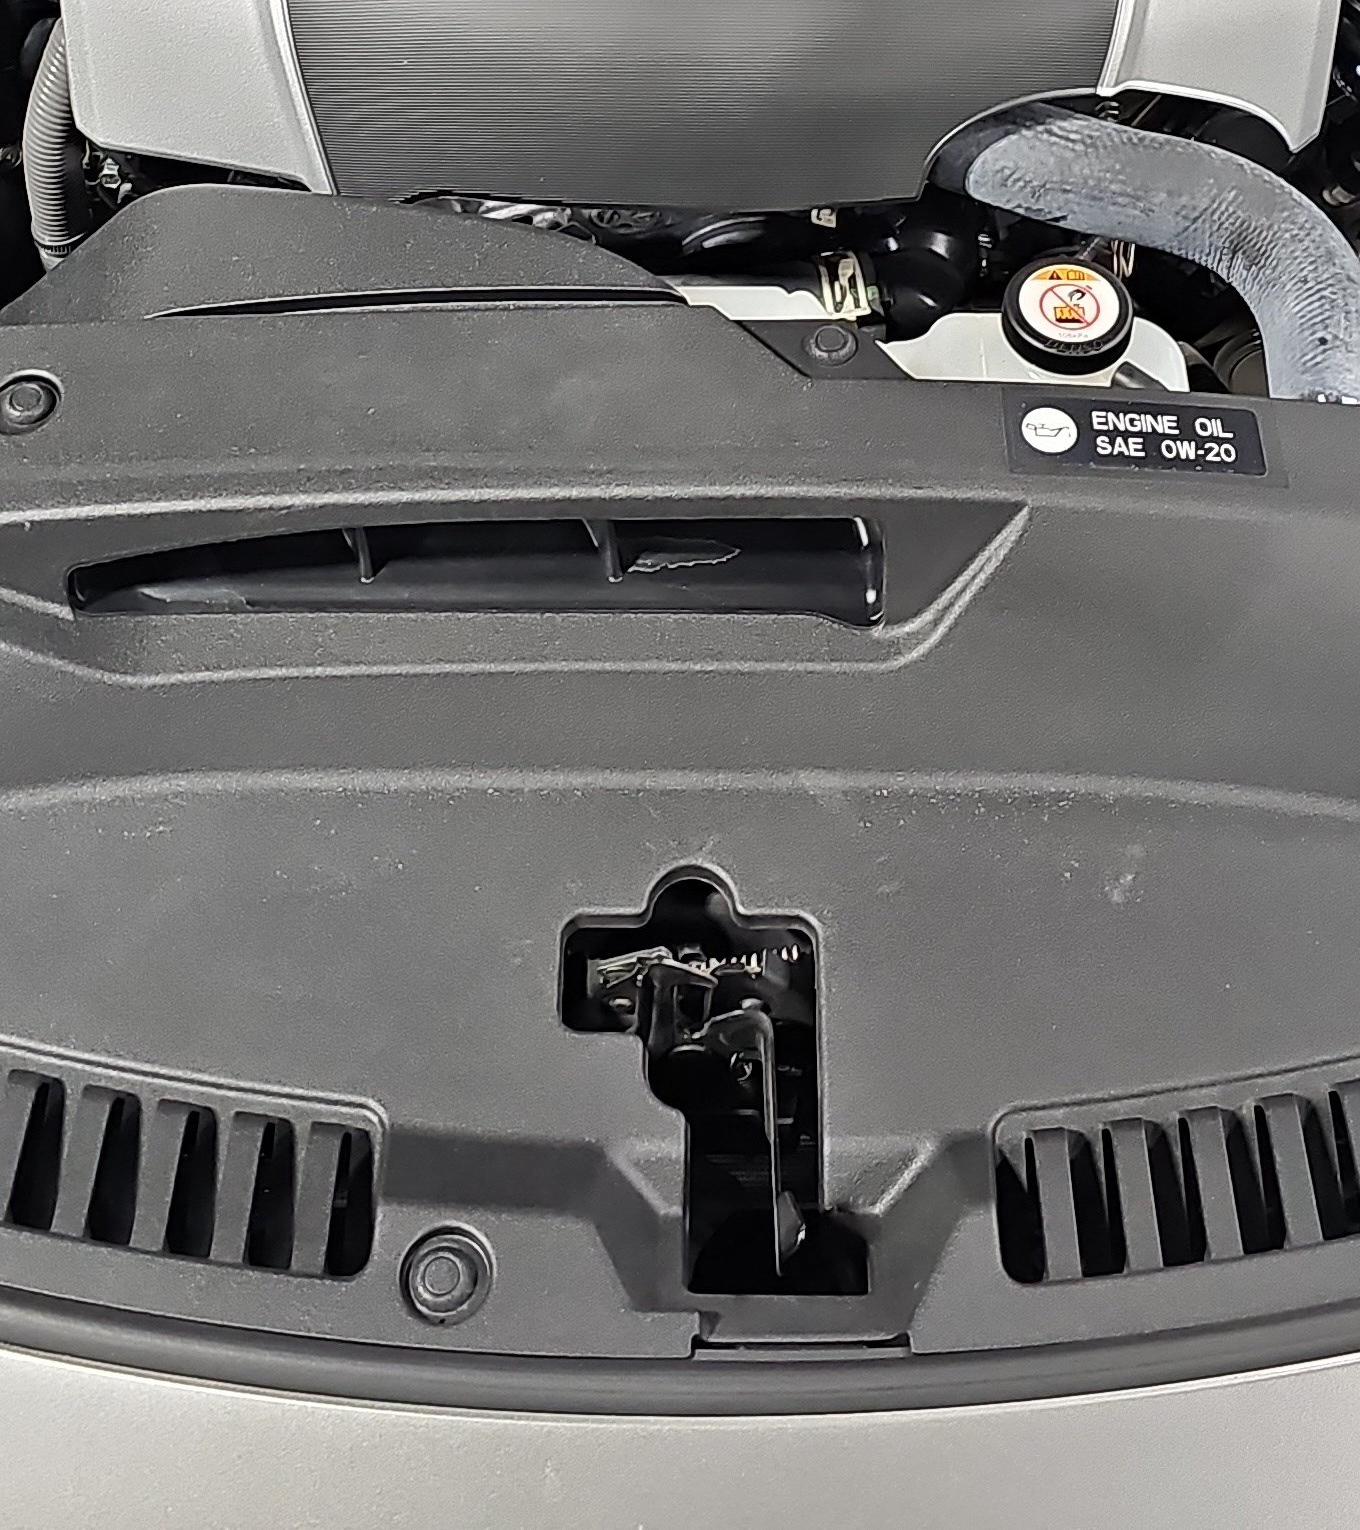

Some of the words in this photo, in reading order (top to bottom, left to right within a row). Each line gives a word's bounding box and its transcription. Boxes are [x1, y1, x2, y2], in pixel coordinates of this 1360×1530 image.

[1092, 410, 1179, 436] ENGINE
[1194, 416, 1234, 439] OIL
[1096, 436, 1146, 458] SAE
[1160, 440, 1237, 463] 0W-20
